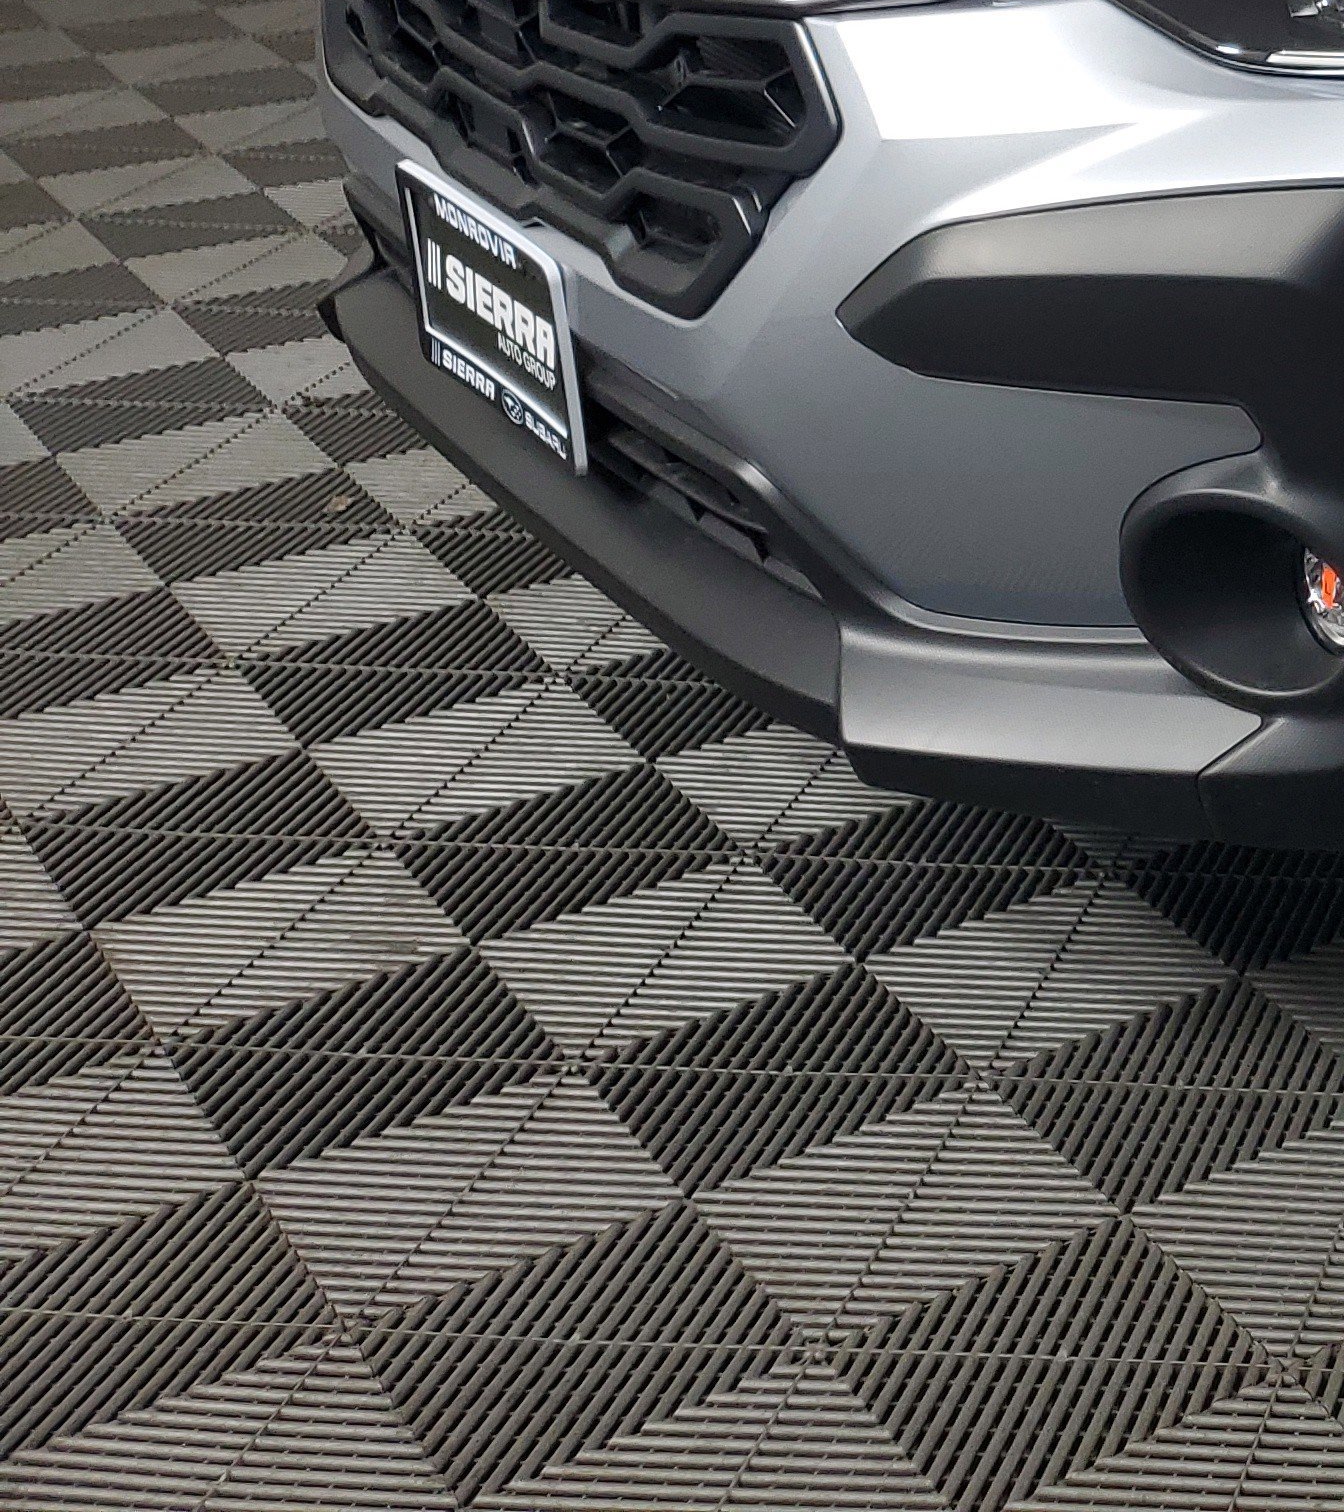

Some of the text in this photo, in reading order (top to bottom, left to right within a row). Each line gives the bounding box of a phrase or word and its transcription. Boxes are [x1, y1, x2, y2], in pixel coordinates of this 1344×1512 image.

[433, 192, 517, 270] MONROVIA
[445, 254, 556, 370] SIERRA
[442, 348, 496, 401] SIERRA
[497, 331, 556, 391] AUTO GROUP
